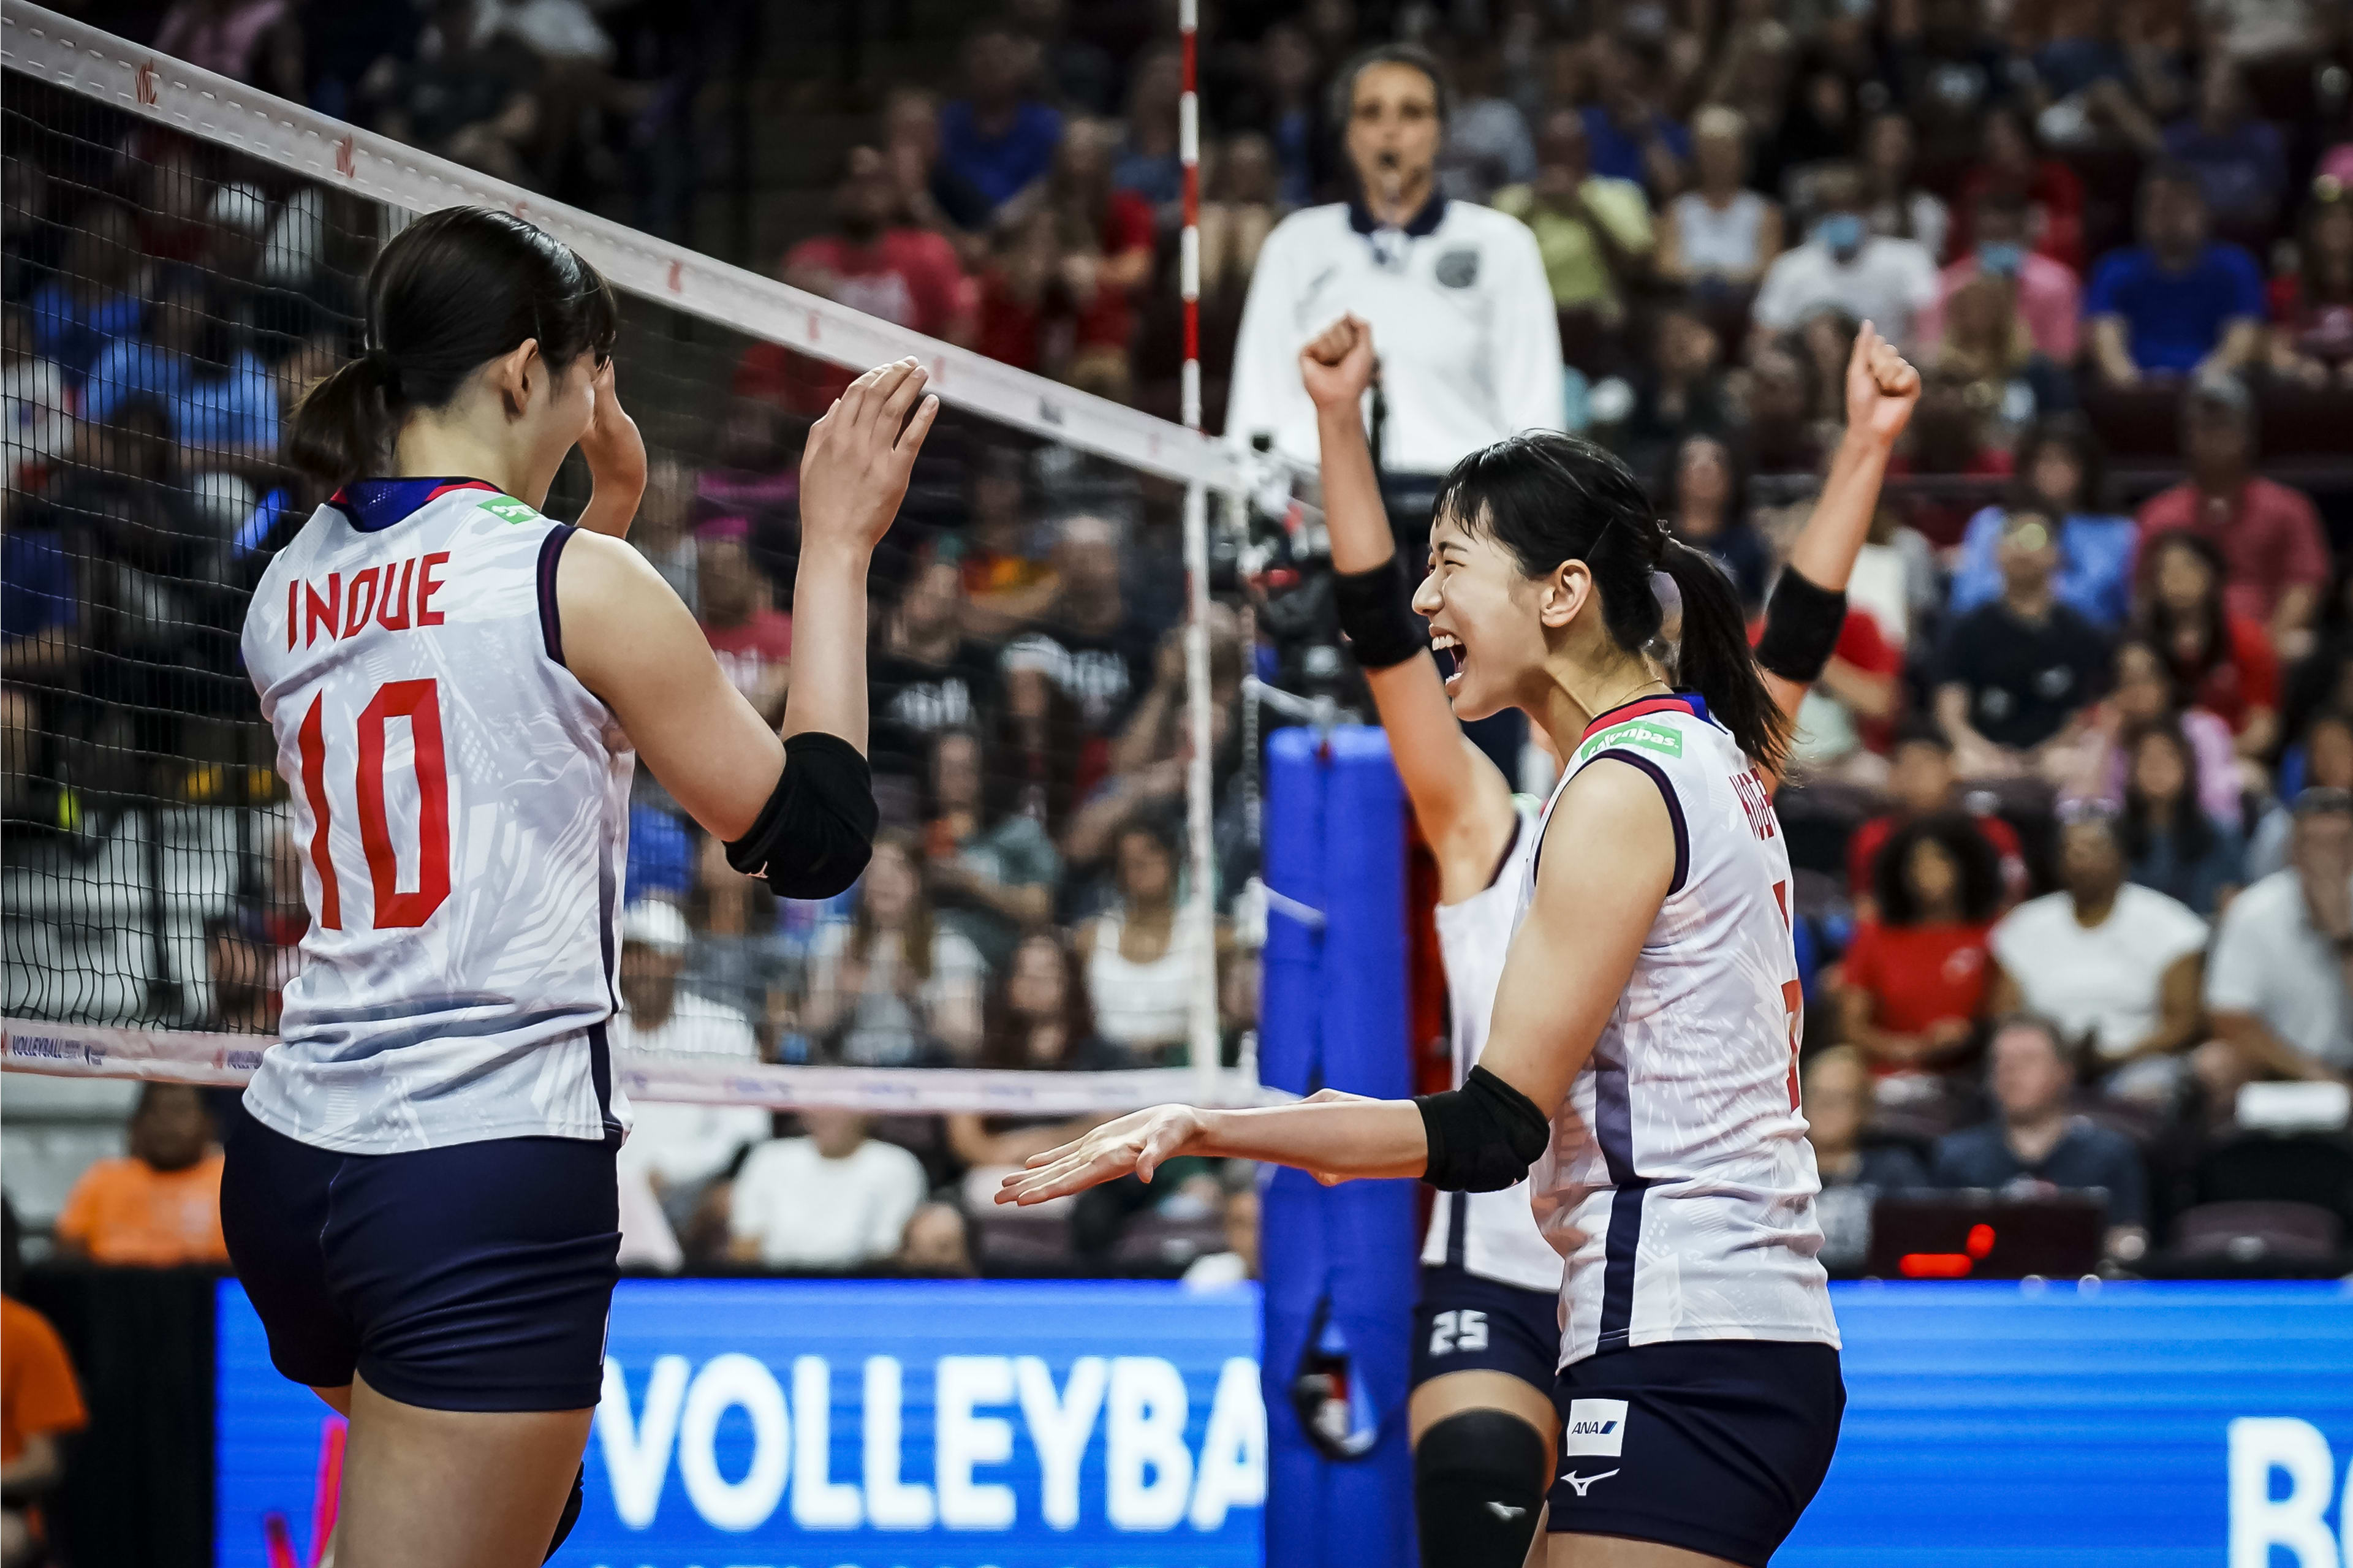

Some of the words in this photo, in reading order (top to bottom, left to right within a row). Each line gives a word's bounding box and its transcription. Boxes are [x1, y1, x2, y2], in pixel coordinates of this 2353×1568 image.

[288, 551, 450, 653] INOUE
[298, 679, 450, 930] 10
[1428, 1309, 1489, 1357] 25
[1571, 1420, 1599, 1434] ANA
